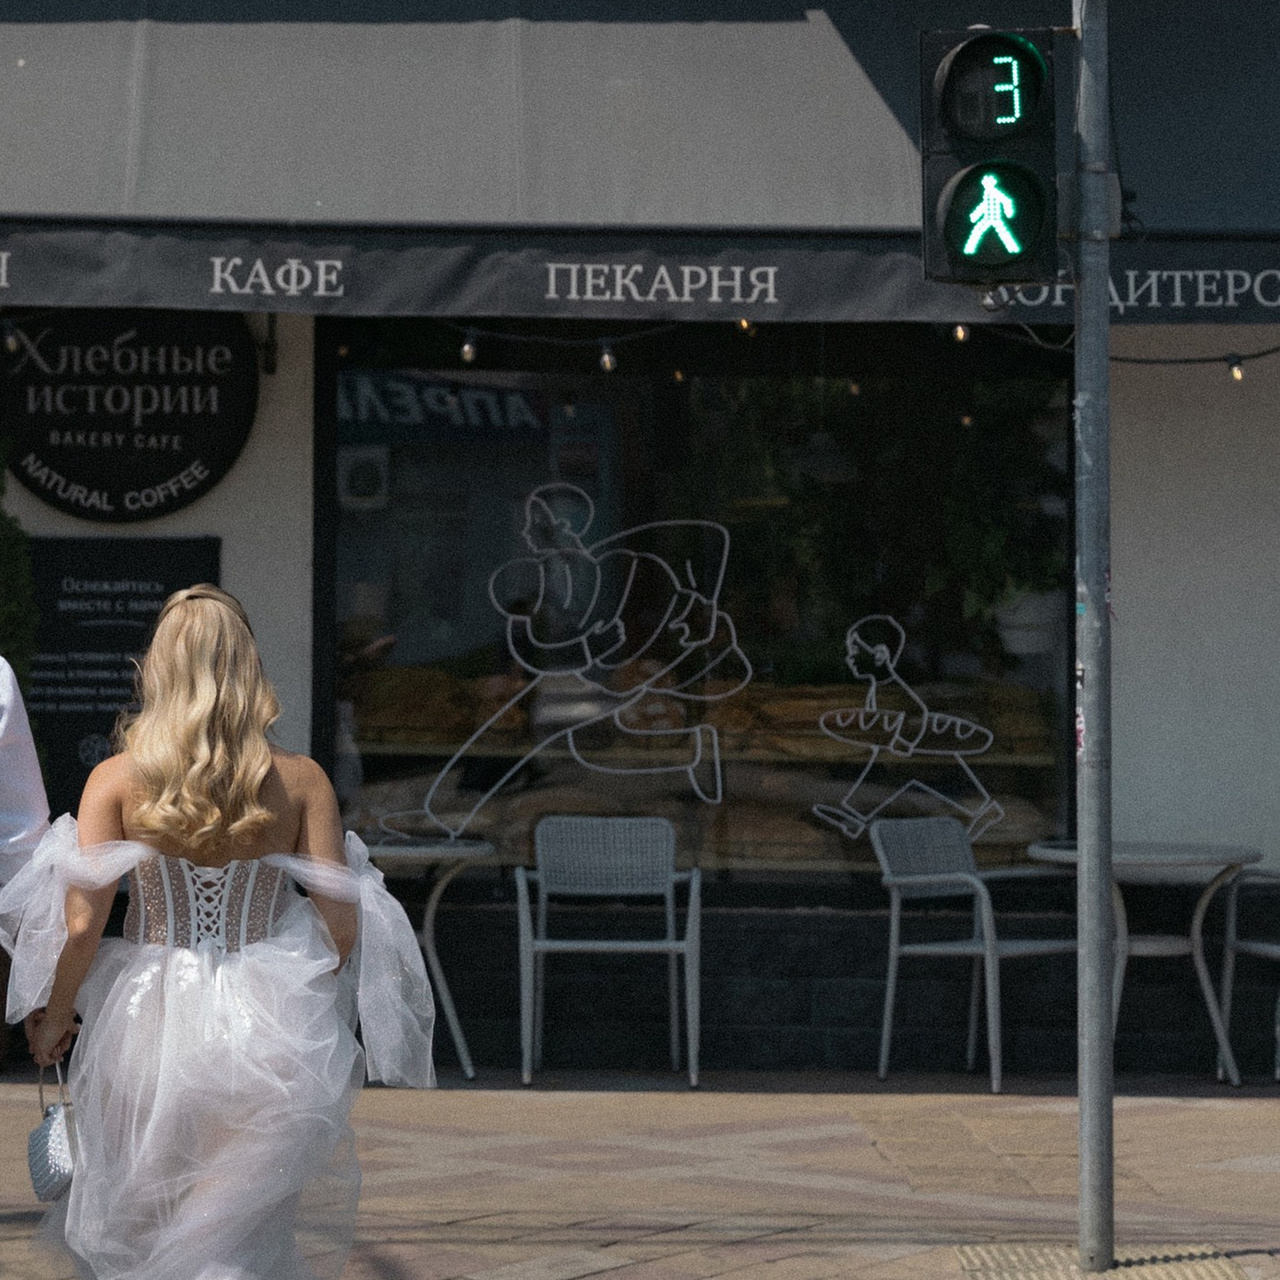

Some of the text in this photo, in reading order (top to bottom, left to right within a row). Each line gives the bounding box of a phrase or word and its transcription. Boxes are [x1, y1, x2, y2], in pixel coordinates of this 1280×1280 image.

[993, 56, 1020, 124] 3
[209, 256, 345, 298] КАФЕ
[545, 263, 780, 304] ПЕКАРНЯ
[9, 328, 232, 375] Хлебные
[25, 384, 220, 427] истории
[49, 430, 183, 451] BAKERY CAFE
[20, 452, 211, 512] NATURAL COFFEE
